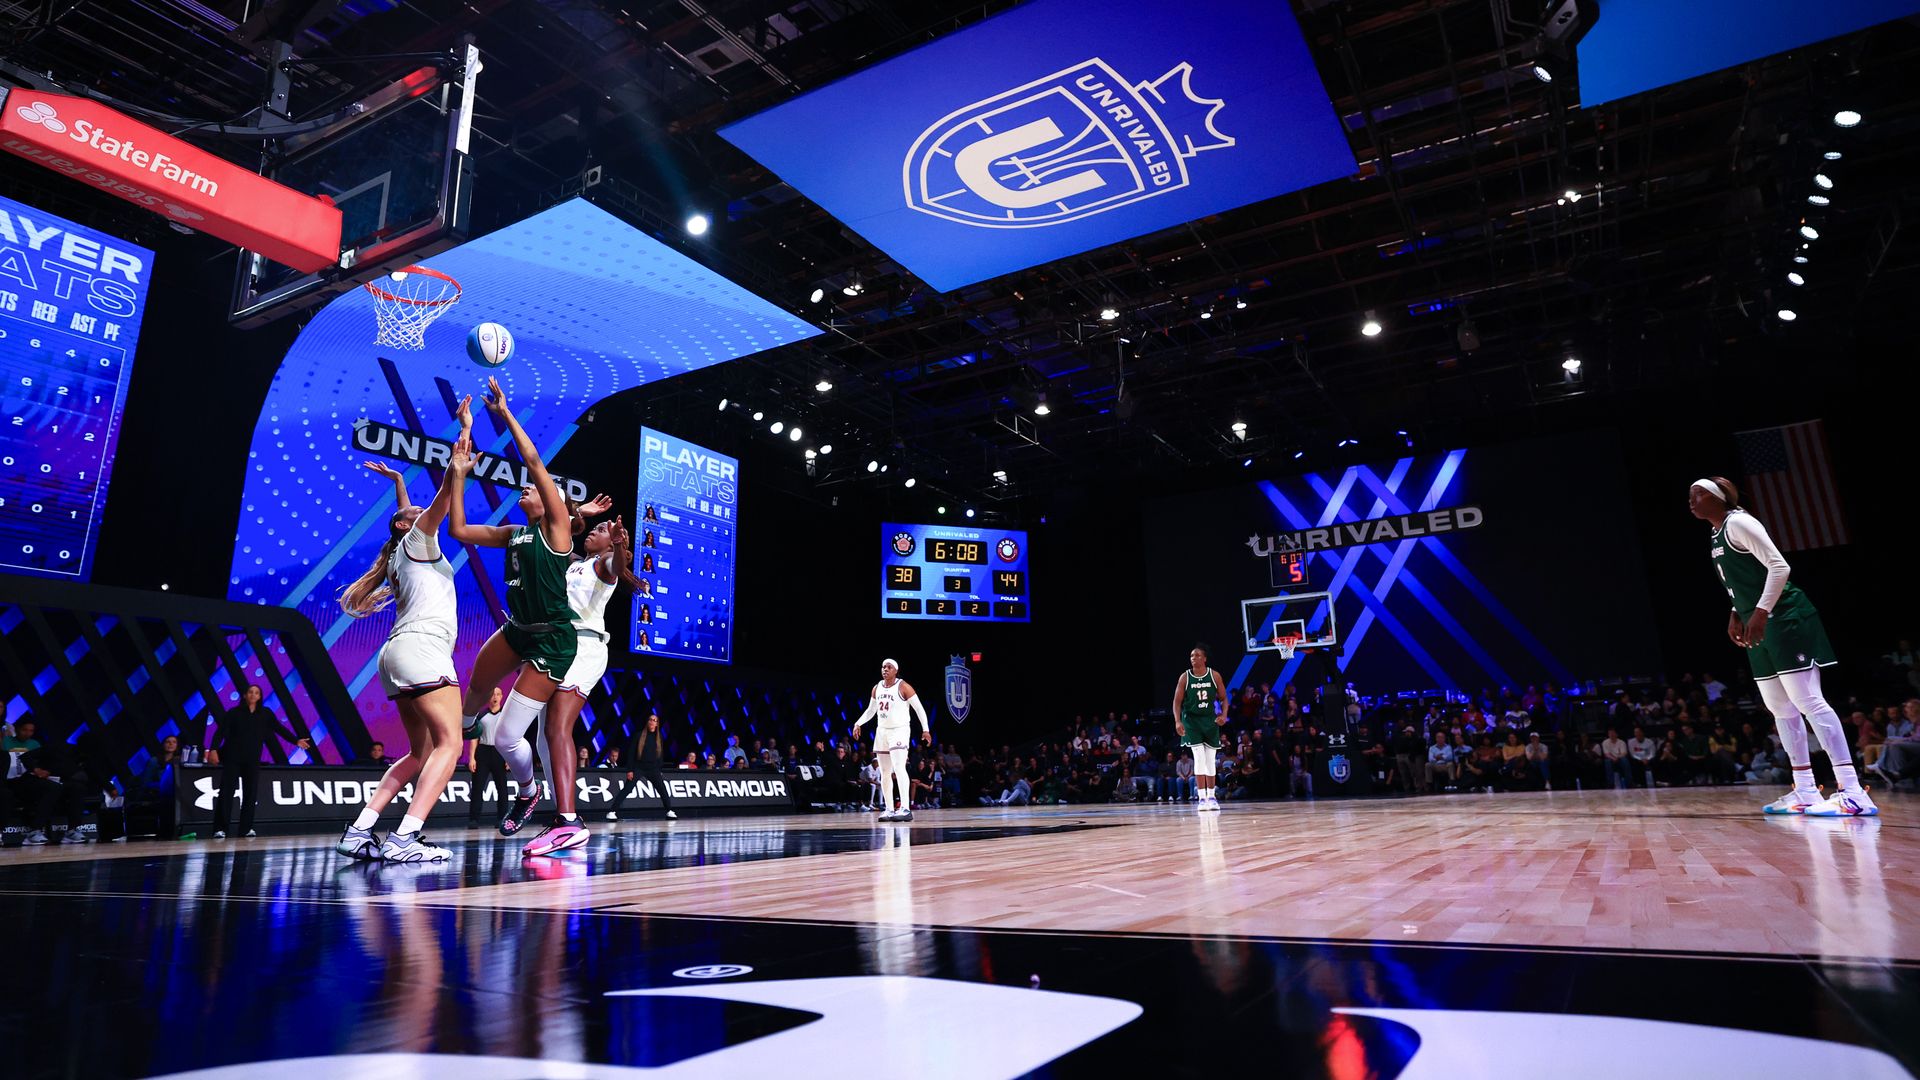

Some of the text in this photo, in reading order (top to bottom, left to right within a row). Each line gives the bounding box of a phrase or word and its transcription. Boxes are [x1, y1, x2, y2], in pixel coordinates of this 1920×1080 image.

[1075, 74, 1172, 187] UNRIVALED
[31, 300, 58, 323] REB
[70, 312, 97, 334] AST
[104, 322, 120, 341] PF
[30, 339, 41, 348] 6
[66, 350, 76, 358] 4
[100, 358, 110, 366] 0
[21, 377, 101, 404] 6 2 1
[12, 417, 95, 441] 2 1 2
[3, 457, 14, 465] 0
[40, 464, 51, 473] 0
[357, 427, 587, 502] UNRVALD
[645, 435, 735, 481] PLAYER
[644, 457, 735, 504] STATS
[32, 504, 77, 519] 0 1
[934, 530, 979, 539] UNRIVALED
[22, 545, 70, 559] 0 0
[935, 543, 978, 561] 6:08
[895, 568, 913, 583] 38
[1001, 574, 1017, 587] 44
[1289, 563, 1302, 582] 5
[954, 580, 961, 589] 3
[901, 601, 1013, 614] 0 2 2 1
[951, 682, 966, 709] U
[1197, 690, 1208, 700] 12
[879, 701, 889, 711] 24
[1334, 765, 1346, 777] U
[705, 779, 787, 797] ARMOUR
